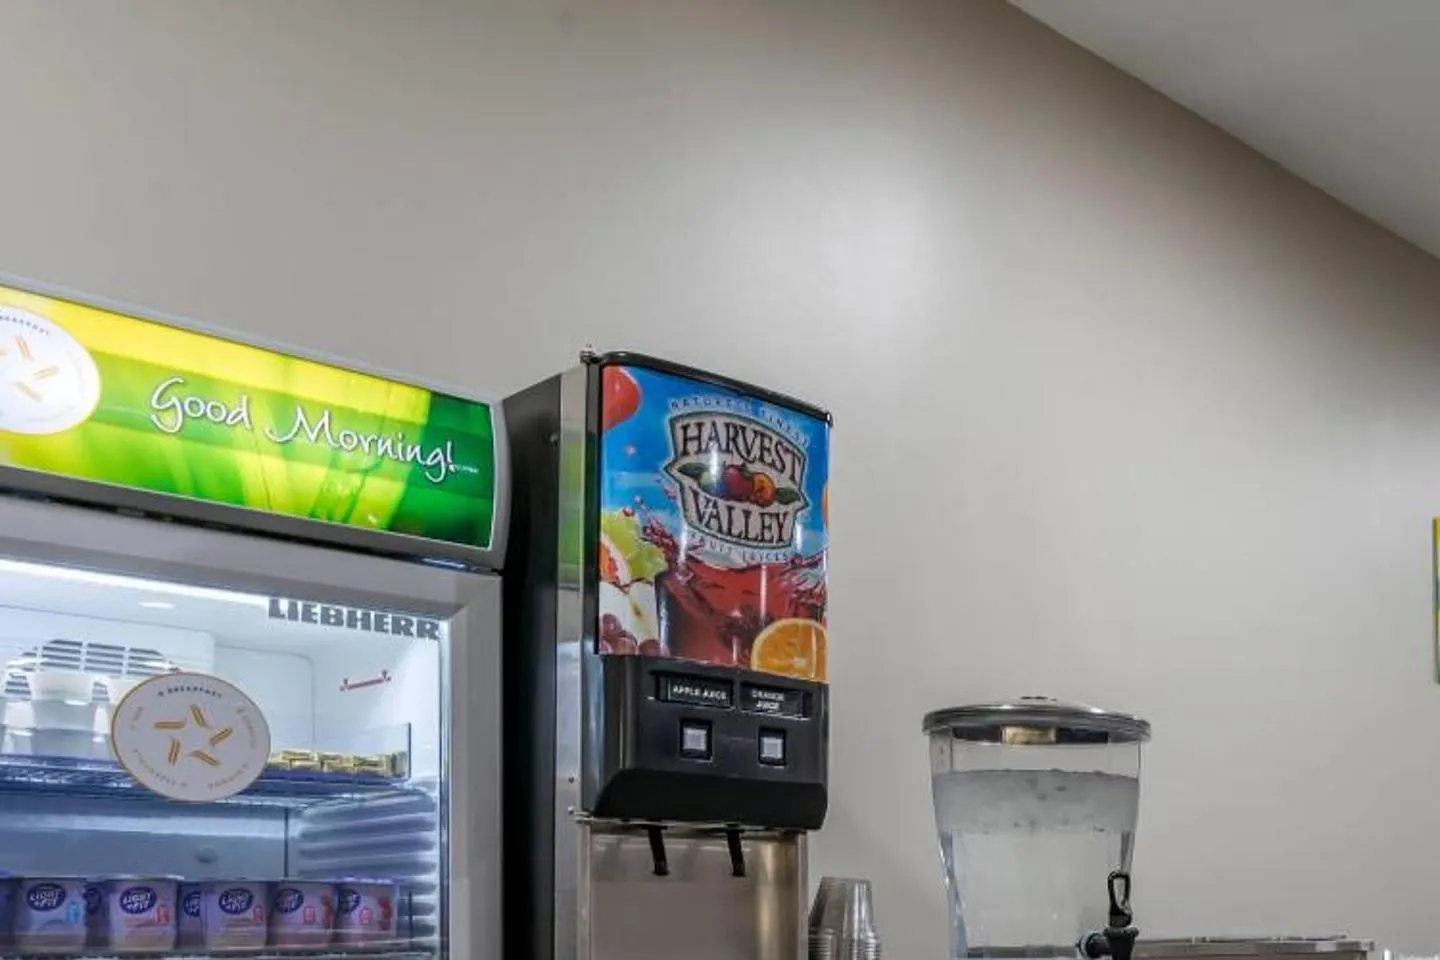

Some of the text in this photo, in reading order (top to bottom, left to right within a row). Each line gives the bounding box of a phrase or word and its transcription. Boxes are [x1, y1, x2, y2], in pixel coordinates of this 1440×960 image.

[150, 375, 457, 483] Good Morning!
[680, 419, 802, 482] HARVEST
[688, 485, 789, 543] VALLEY
[267, 598, 441, 641] LIEBHERR
